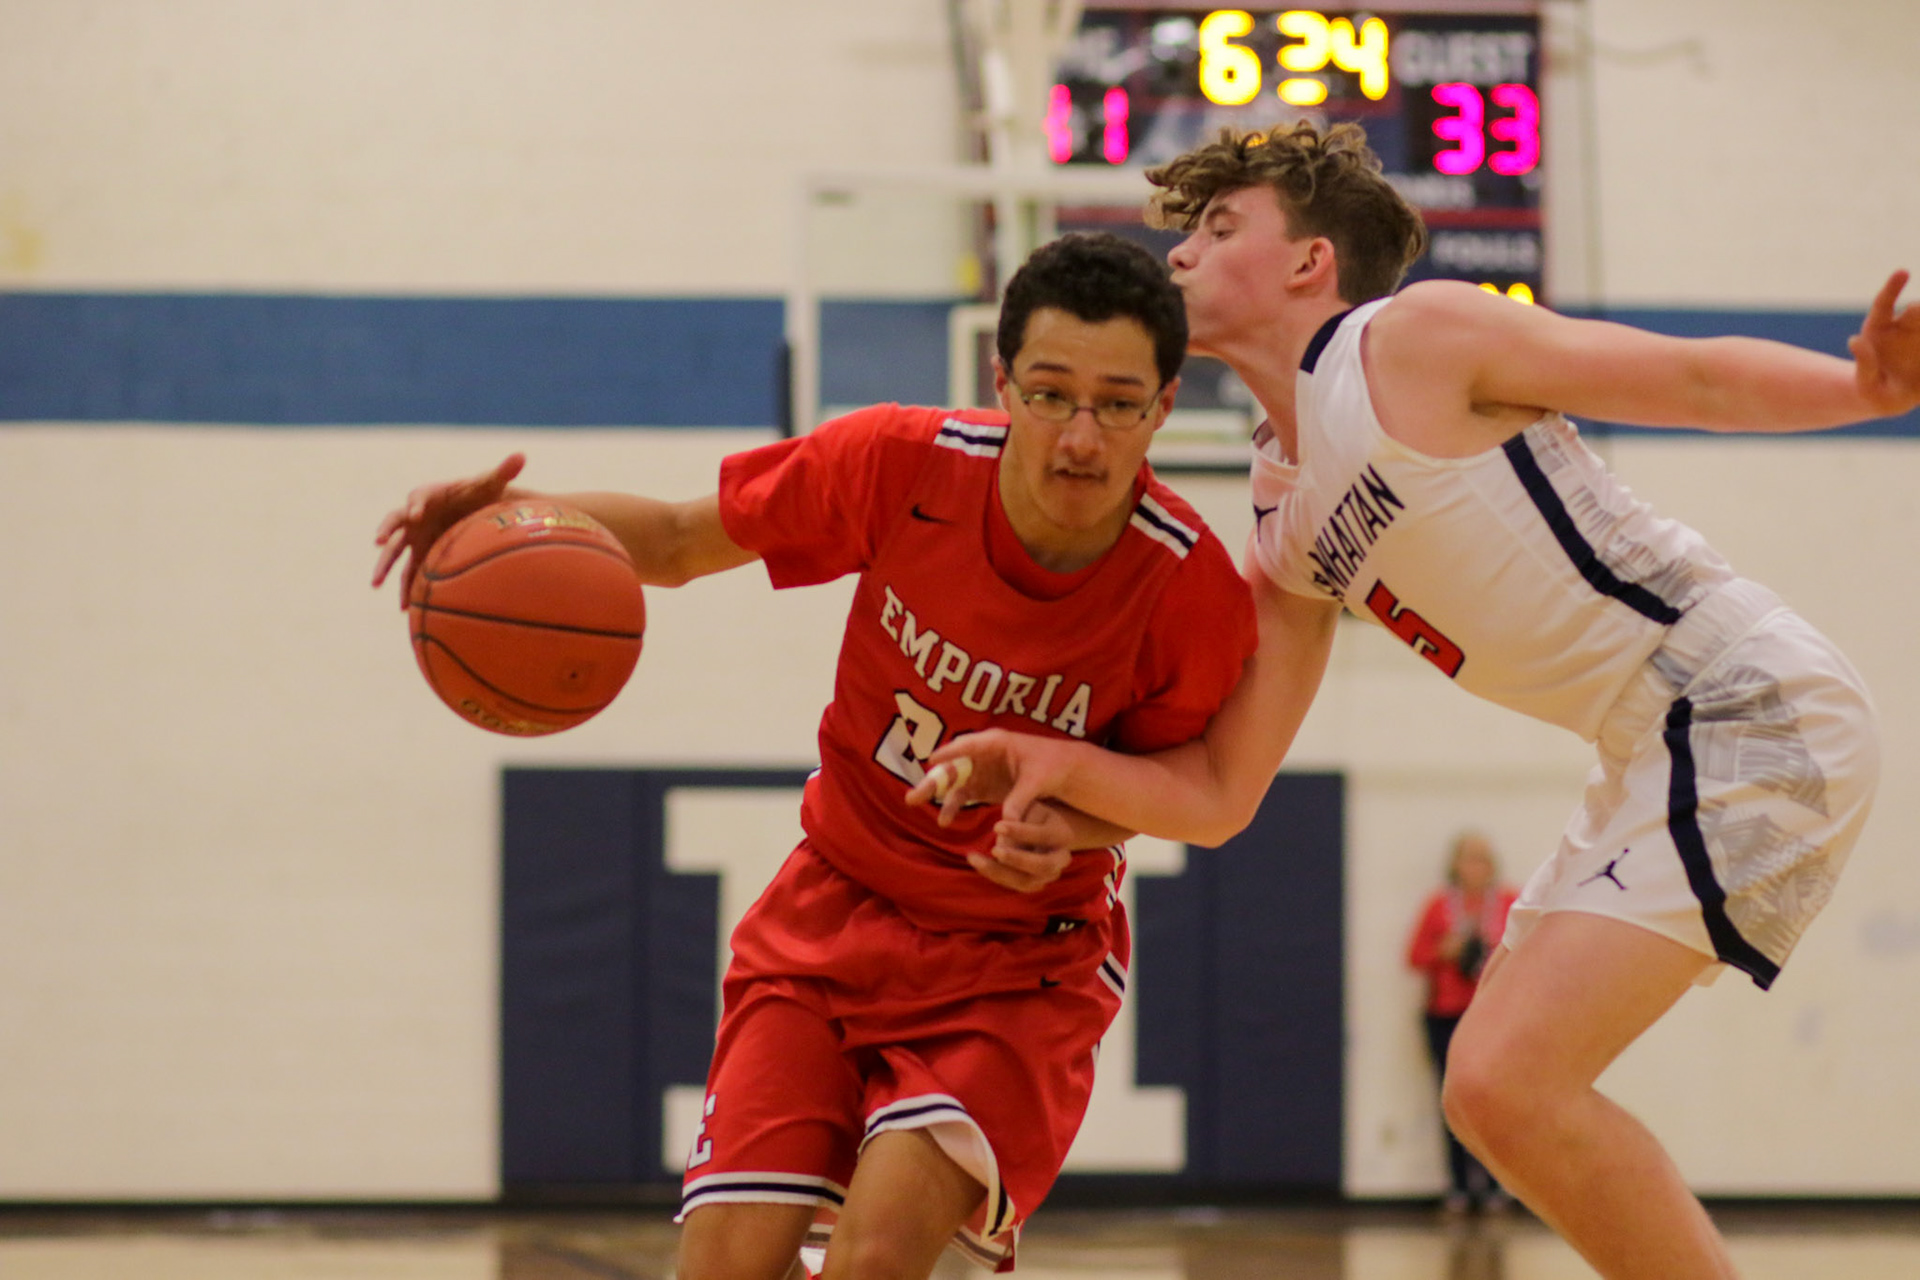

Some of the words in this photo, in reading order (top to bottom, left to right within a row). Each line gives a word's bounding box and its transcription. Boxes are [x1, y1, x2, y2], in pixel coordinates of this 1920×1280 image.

[1199, 9, 1262, 106] 6
[1391, 30, 1531, 86] GUEST
[1432, 82, 1540, 176] 33
[879, 584, 1092, 738] EMPORIA
[1364, 577, 1466, 679] 5
[873, 688, 993, 811] 2
